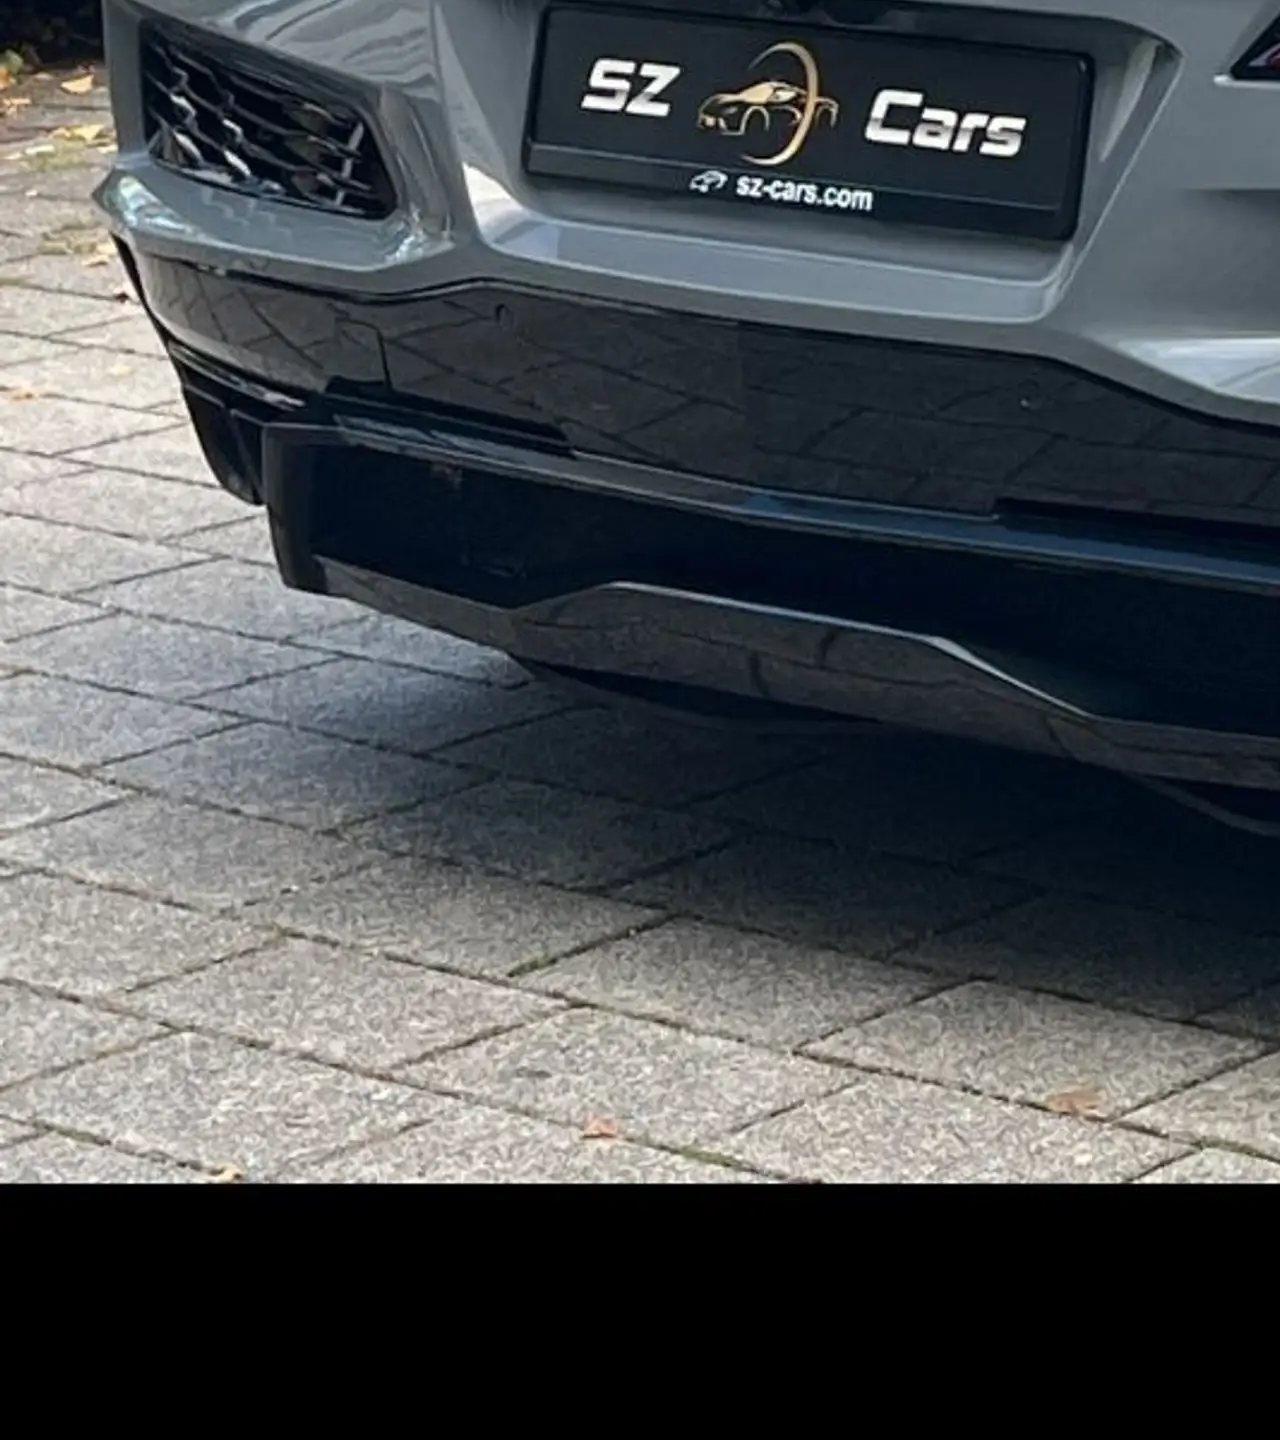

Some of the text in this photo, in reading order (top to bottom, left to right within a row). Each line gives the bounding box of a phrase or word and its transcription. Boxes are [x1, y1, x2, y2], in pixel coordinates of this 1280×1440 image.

[580, 58, 1027, 157] SZ Cars
[736, 174, 874, 211] sz-cars.com
